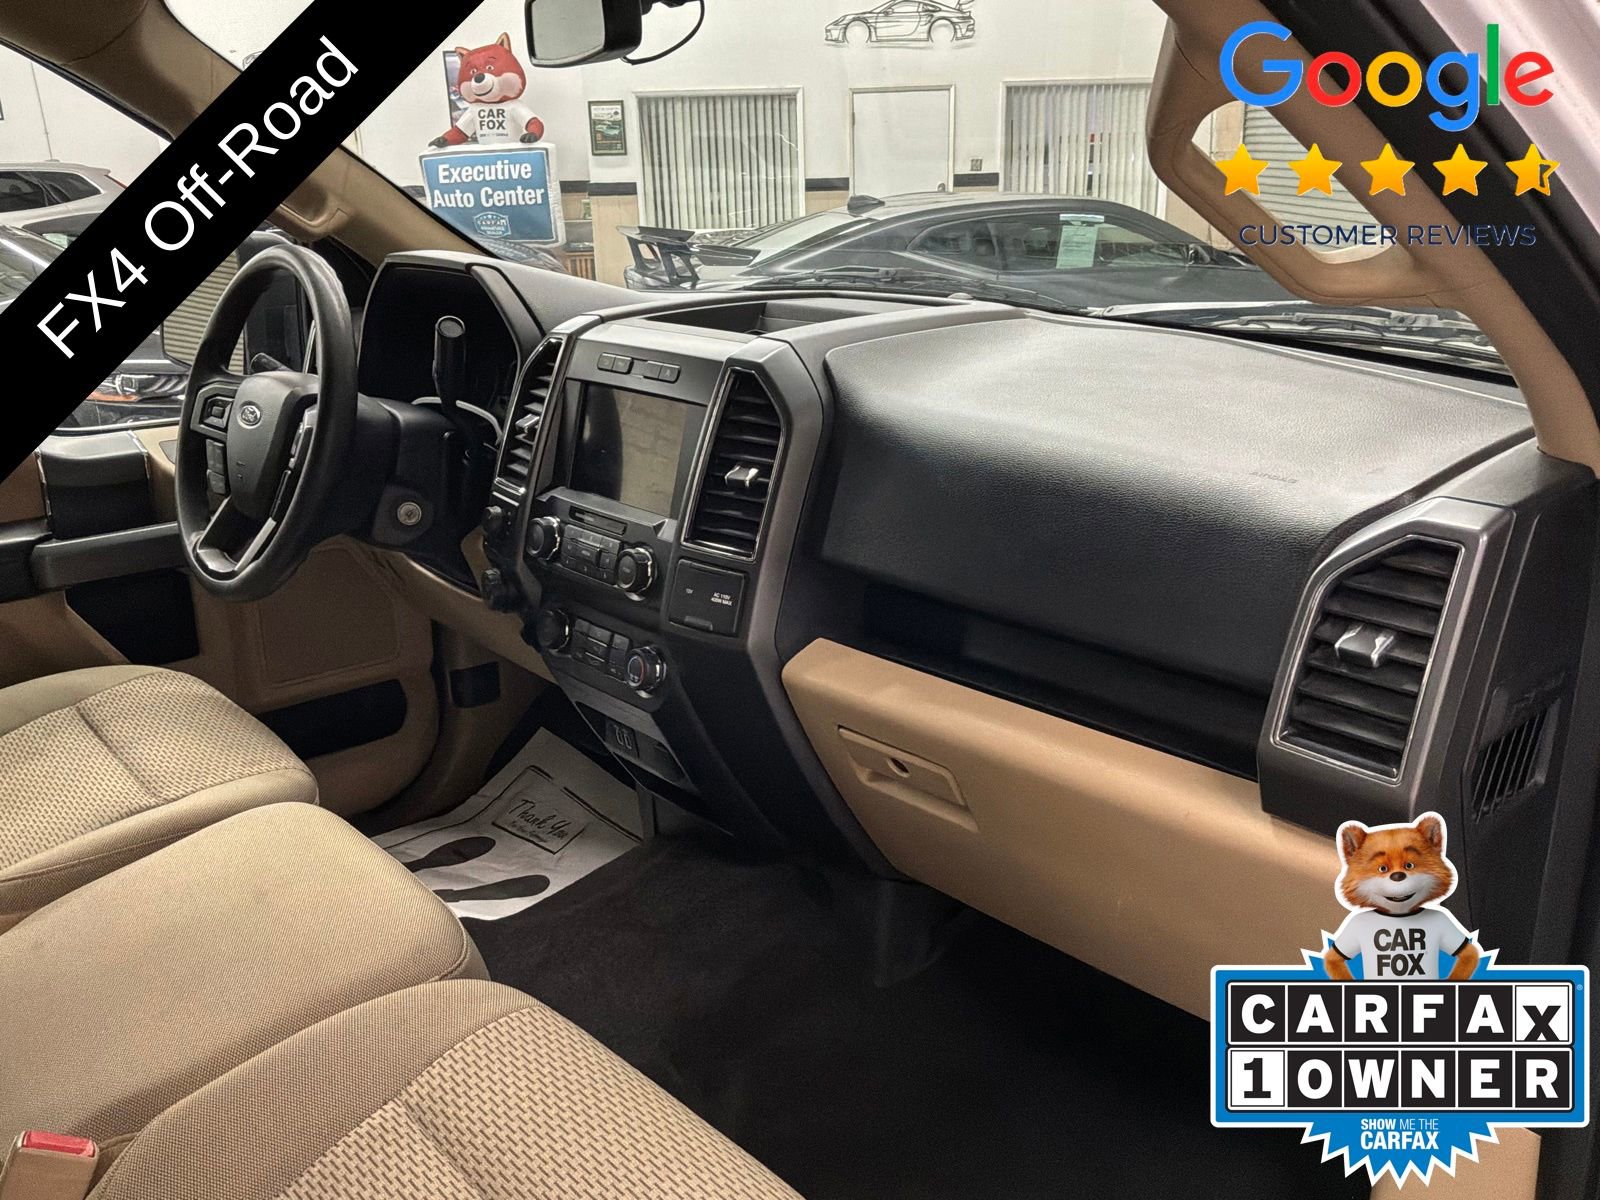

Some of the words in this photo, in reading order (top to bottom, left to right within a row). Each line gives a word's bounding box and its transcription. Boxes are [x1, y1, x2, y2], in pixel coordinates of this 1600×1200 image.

[478, 108, 506, 119] CAR
[479, 119, 506, 130] FOX
[438, 160, 532, 184] Executive
[433, 190, 475, 209] Auto
[480, 186, 545, 208] Center
[509, 799, 557, 829] Thank
